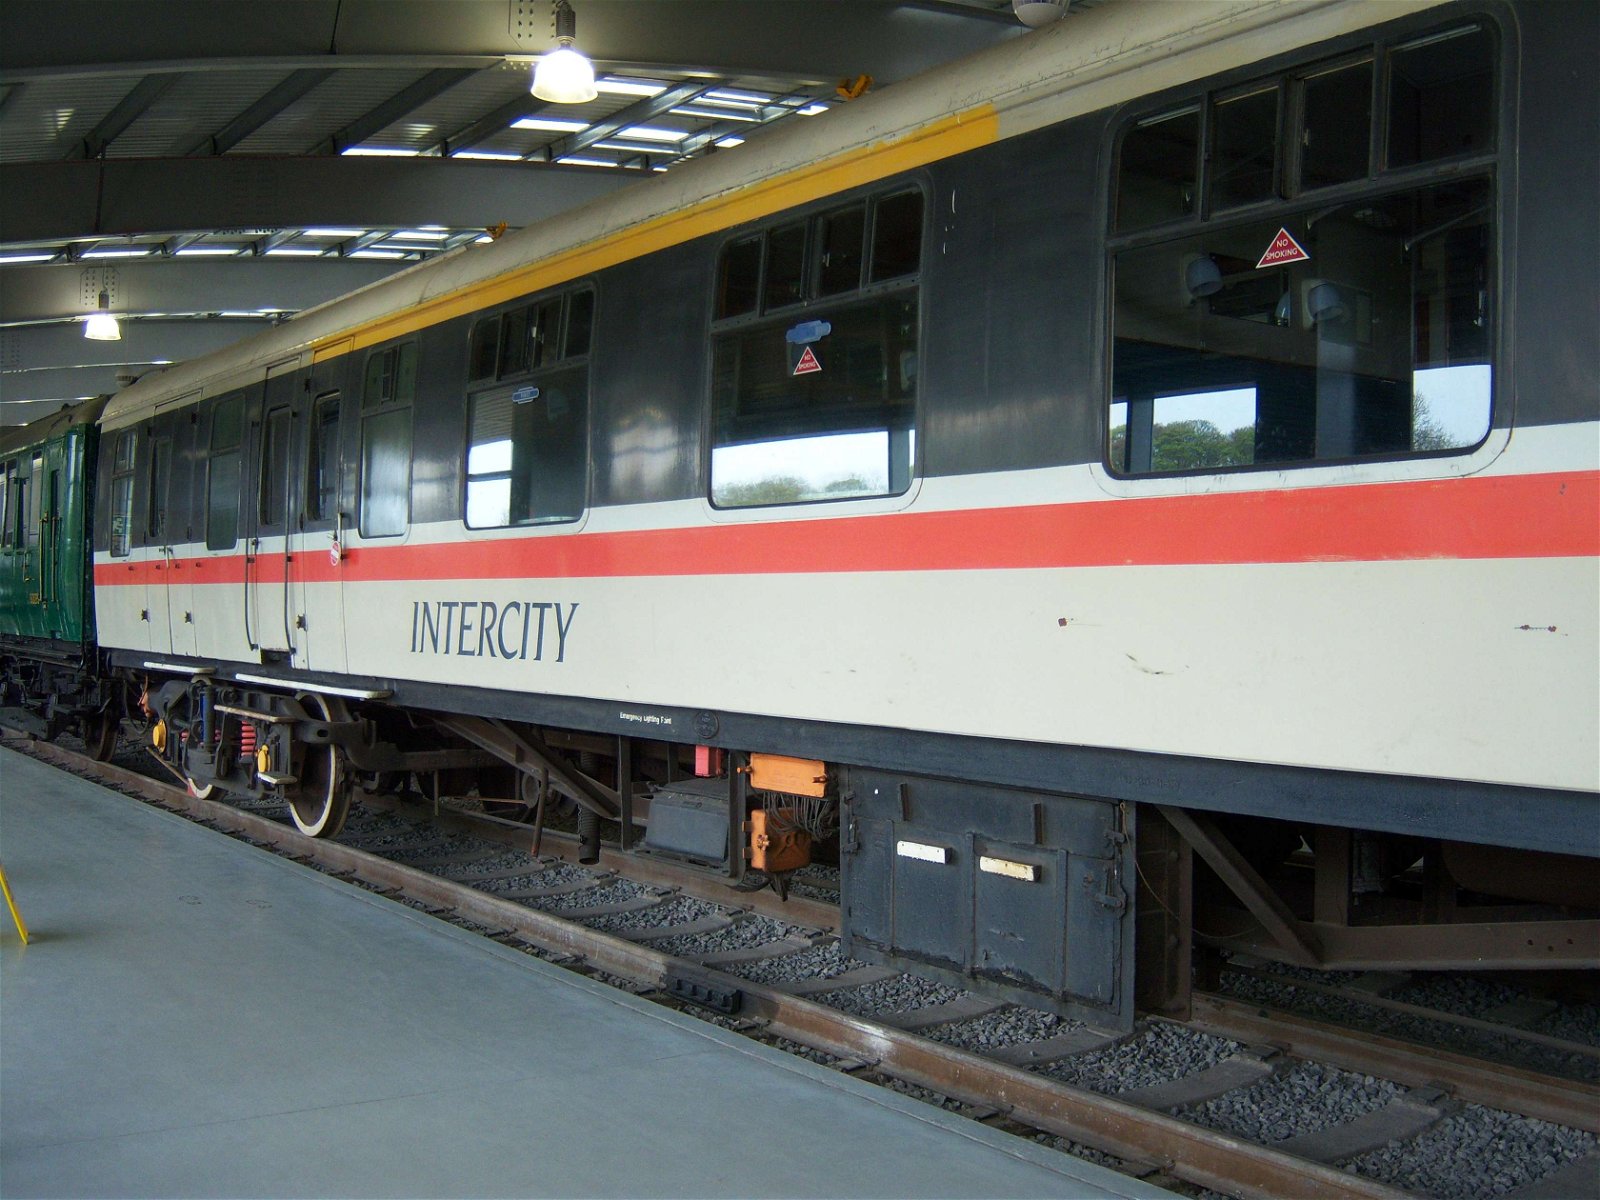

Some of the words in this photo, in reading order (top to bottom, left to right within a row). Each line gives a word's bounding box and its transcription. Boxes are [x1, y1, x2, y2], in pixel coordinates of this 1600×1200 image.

[1276, 239, 1288, 247] NO
[1266, 248, 1298, 260] SMOKING
[411, 600, 580, 663] INTERCITY
